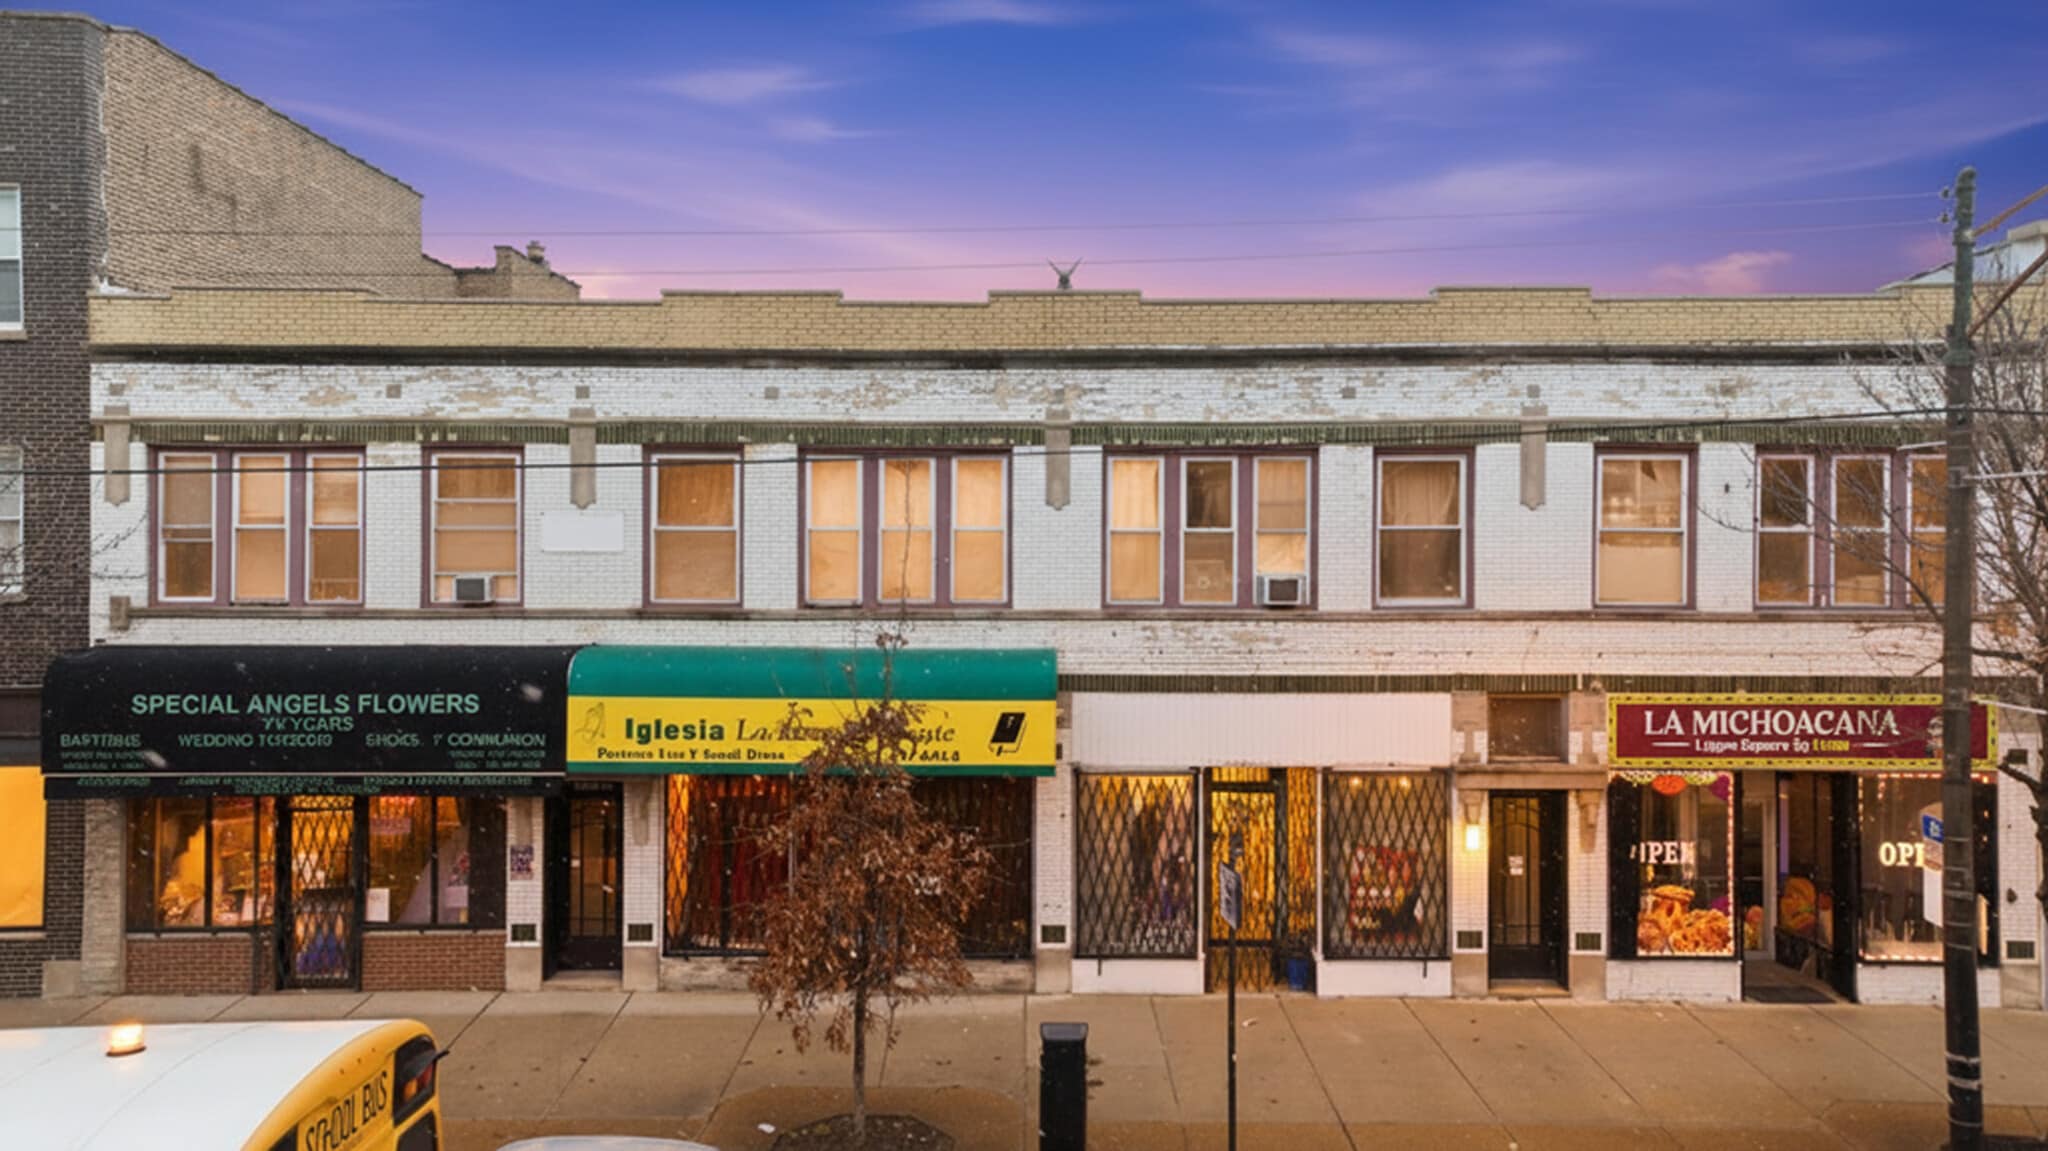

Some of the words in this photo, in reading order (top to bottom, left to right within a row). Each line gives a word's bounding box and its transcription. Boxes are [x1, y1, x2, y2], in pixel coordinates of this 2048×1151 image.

[131, 694, 240, 715] SPECIAL
[246, 694, 350, 715] ANGELS
[357, 694, 480, 715] FLOWERS
[625, 717, 725, 745] Iglesia
[1644, 709, 1686, 736] LA
[1692, 709, 1900, 736] MICHOACANA
[361, 1070, 388, 1125] BUS
